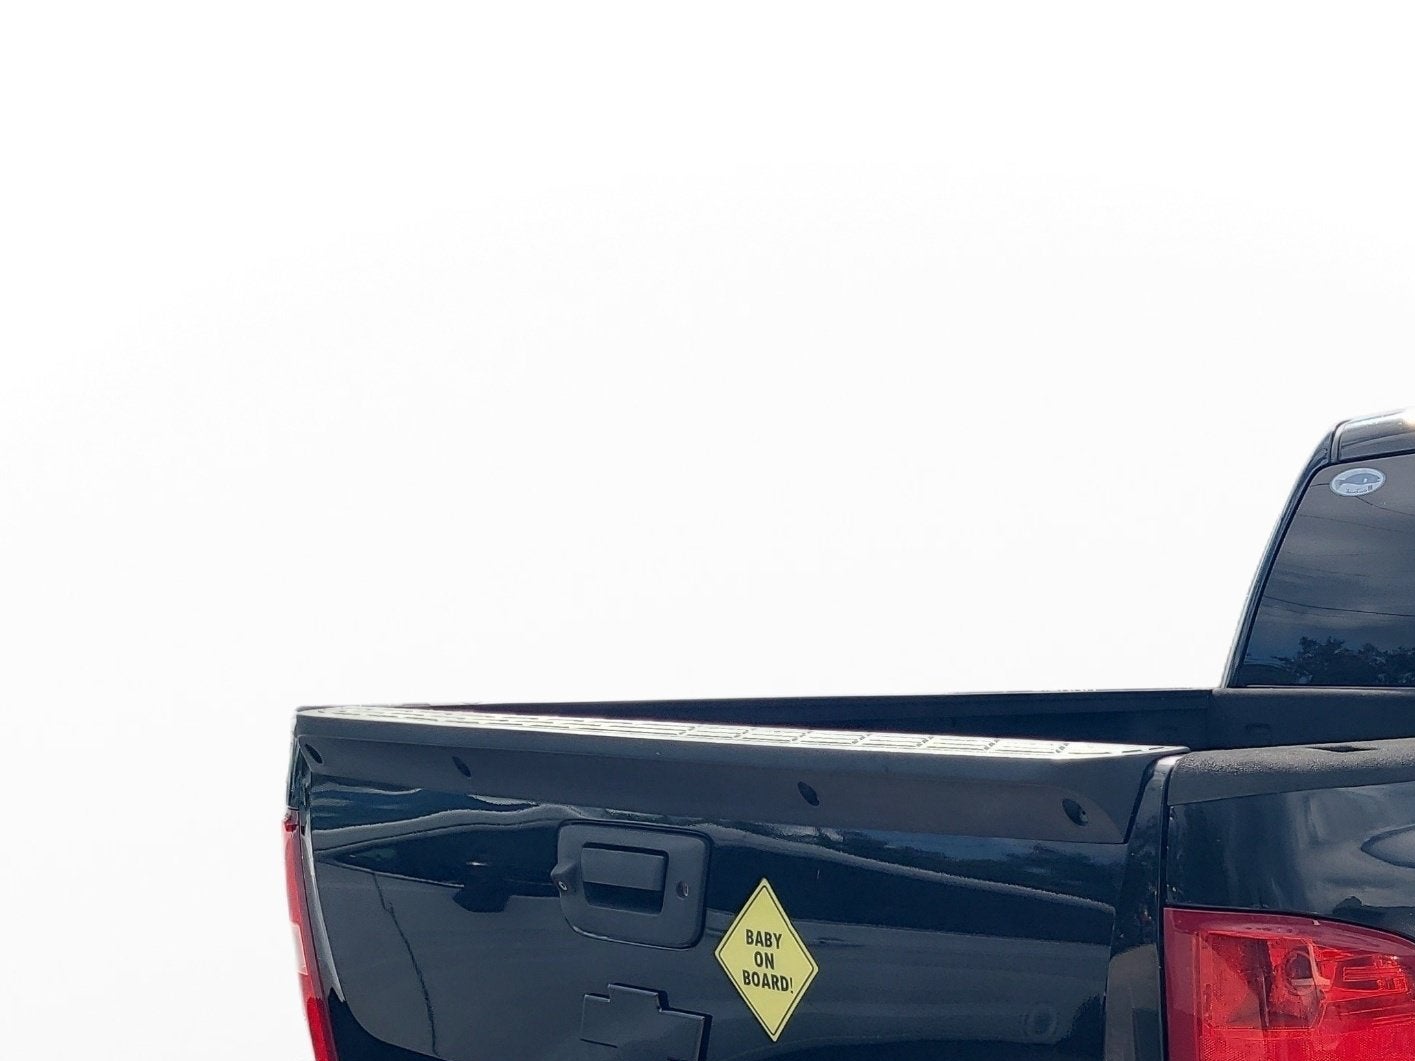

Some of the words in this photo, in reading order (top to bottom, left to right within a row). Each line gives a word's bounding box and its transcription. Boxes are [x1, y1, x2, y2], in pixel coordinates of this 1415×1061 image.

[746, 929, 782, 949] BABY
[754, 951, 775, 969] ON
[743, 970, 794, 994] BOARD!
